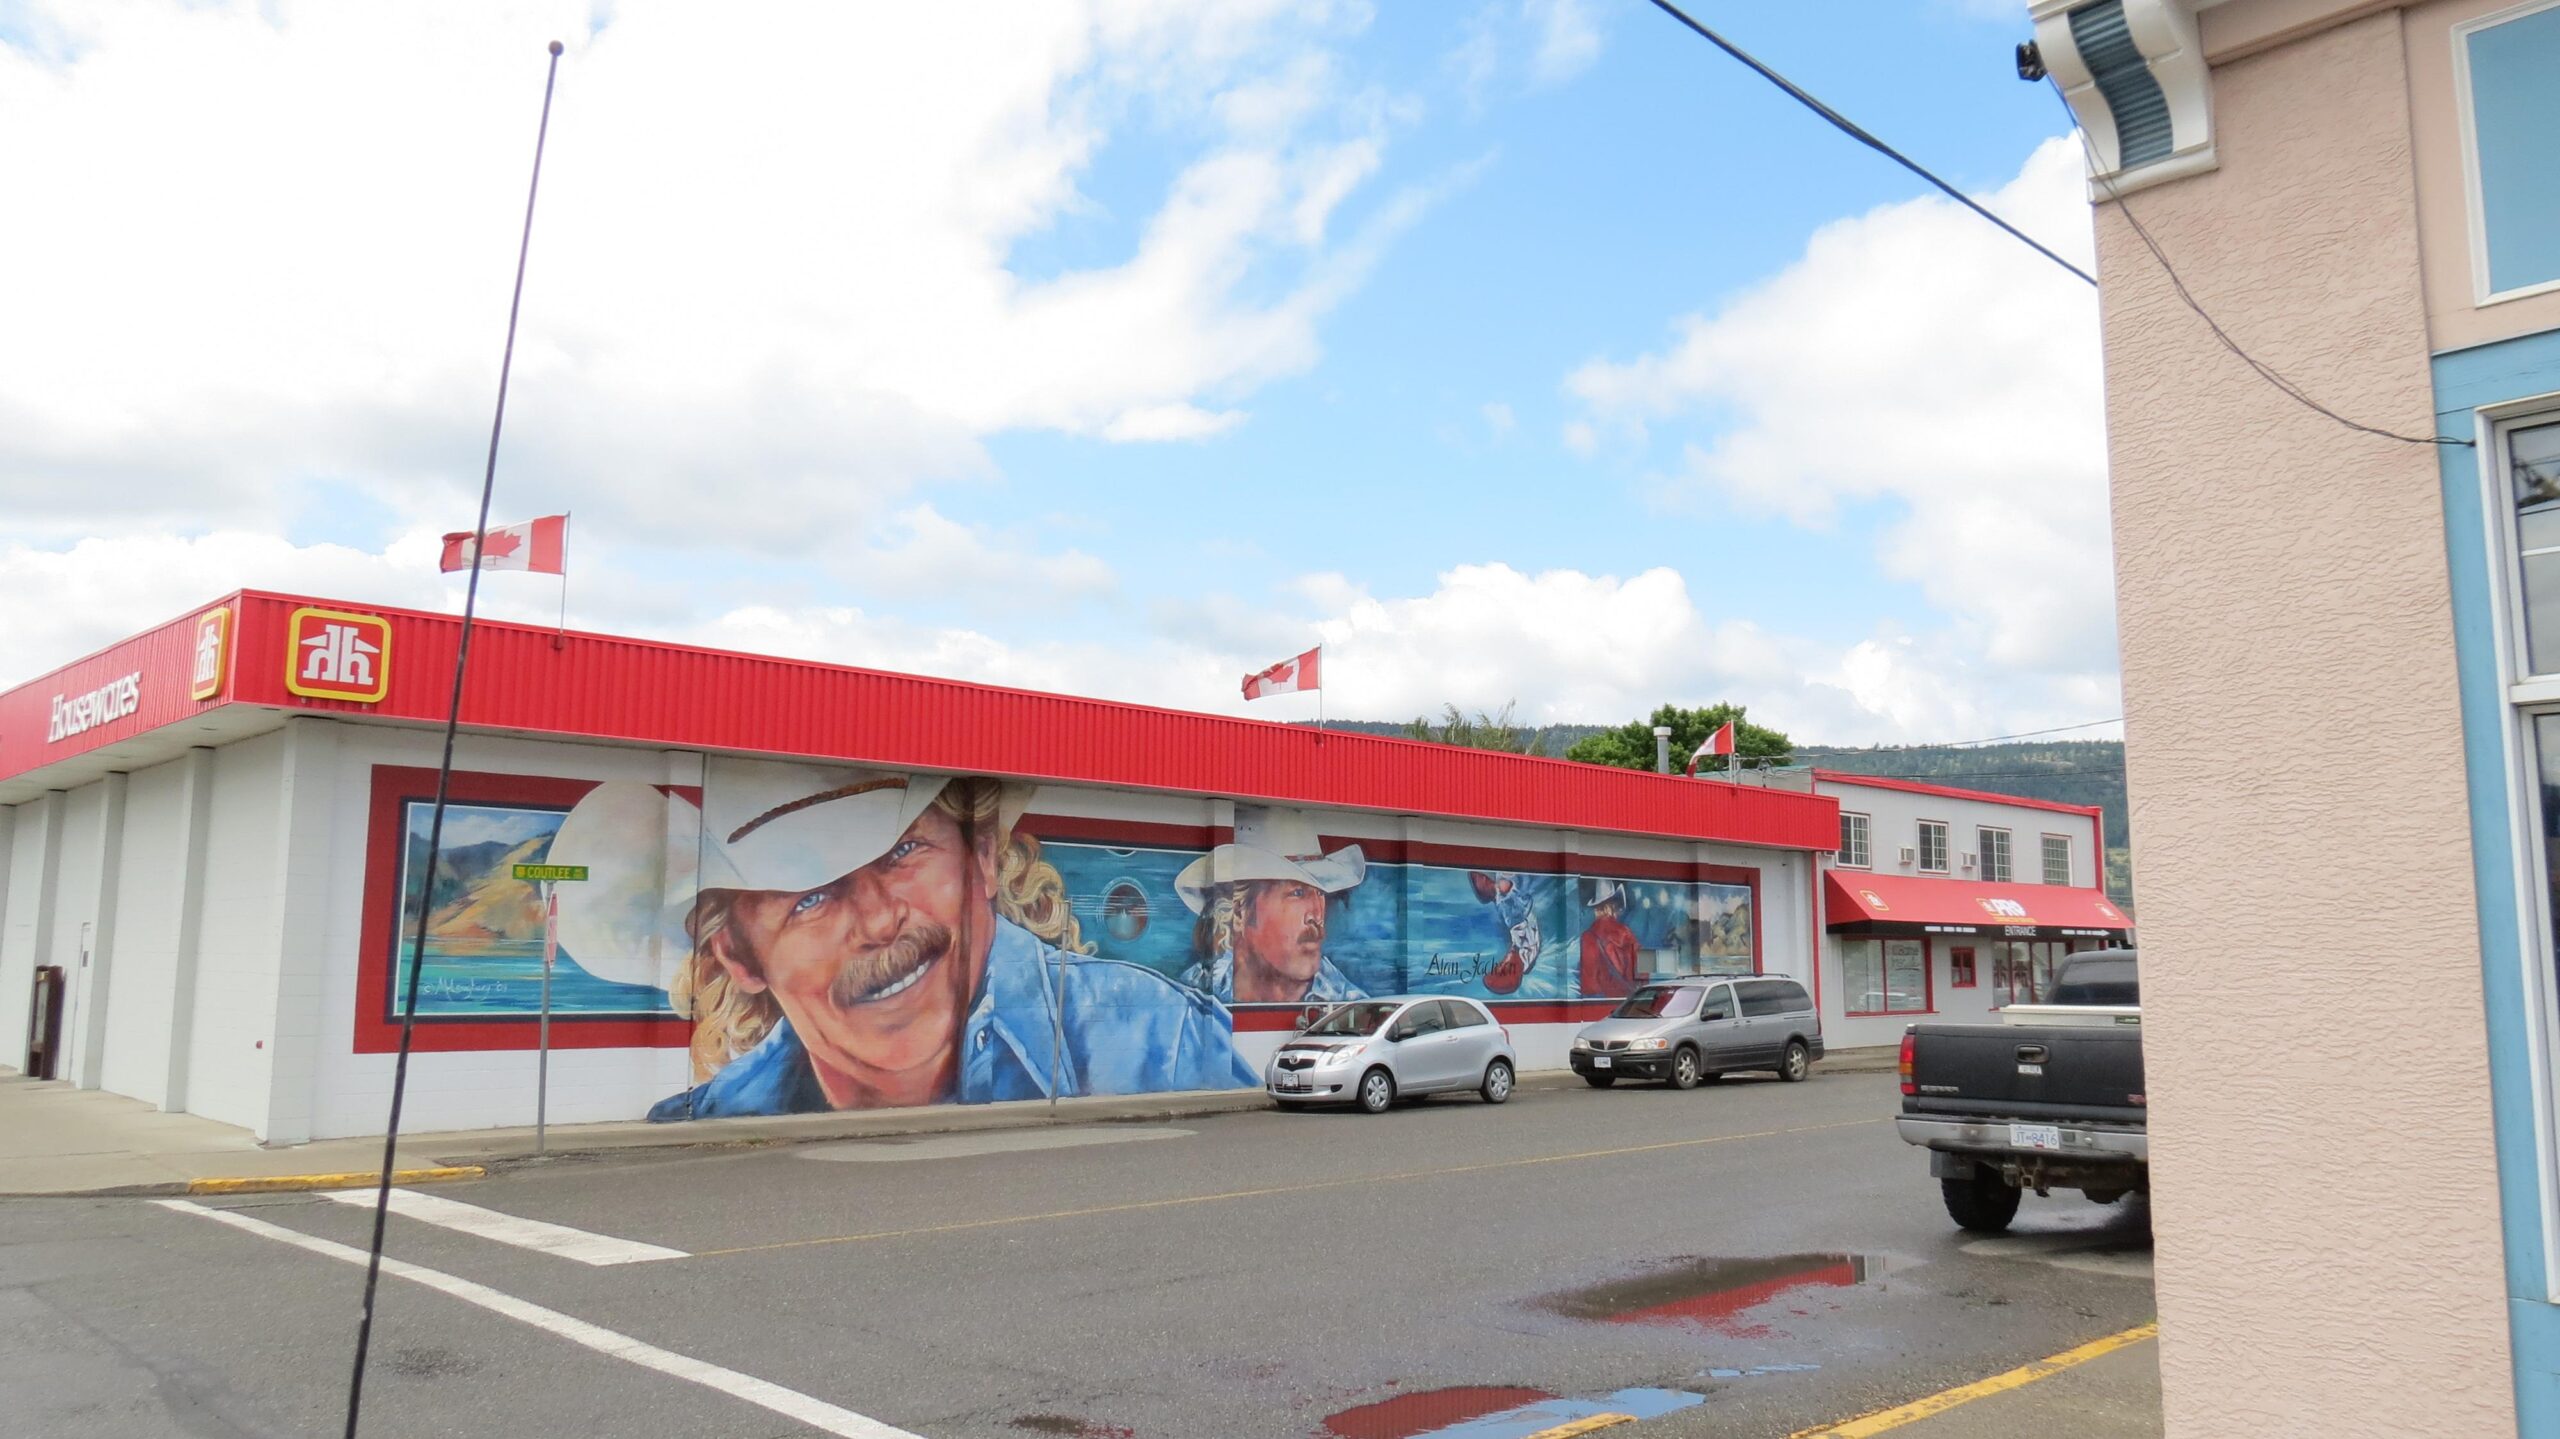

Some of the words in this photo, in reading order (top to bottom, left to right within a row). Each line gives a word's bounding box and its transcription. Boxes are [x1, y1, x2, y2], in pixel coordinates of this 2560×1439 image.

[48, 671, 141, 743] Housewares
[527, 866, 571, 879] COUTLEE
[2004, 925, 2036, 937] ENTRANCE
[1425, 952, 1459, 976] Alan
